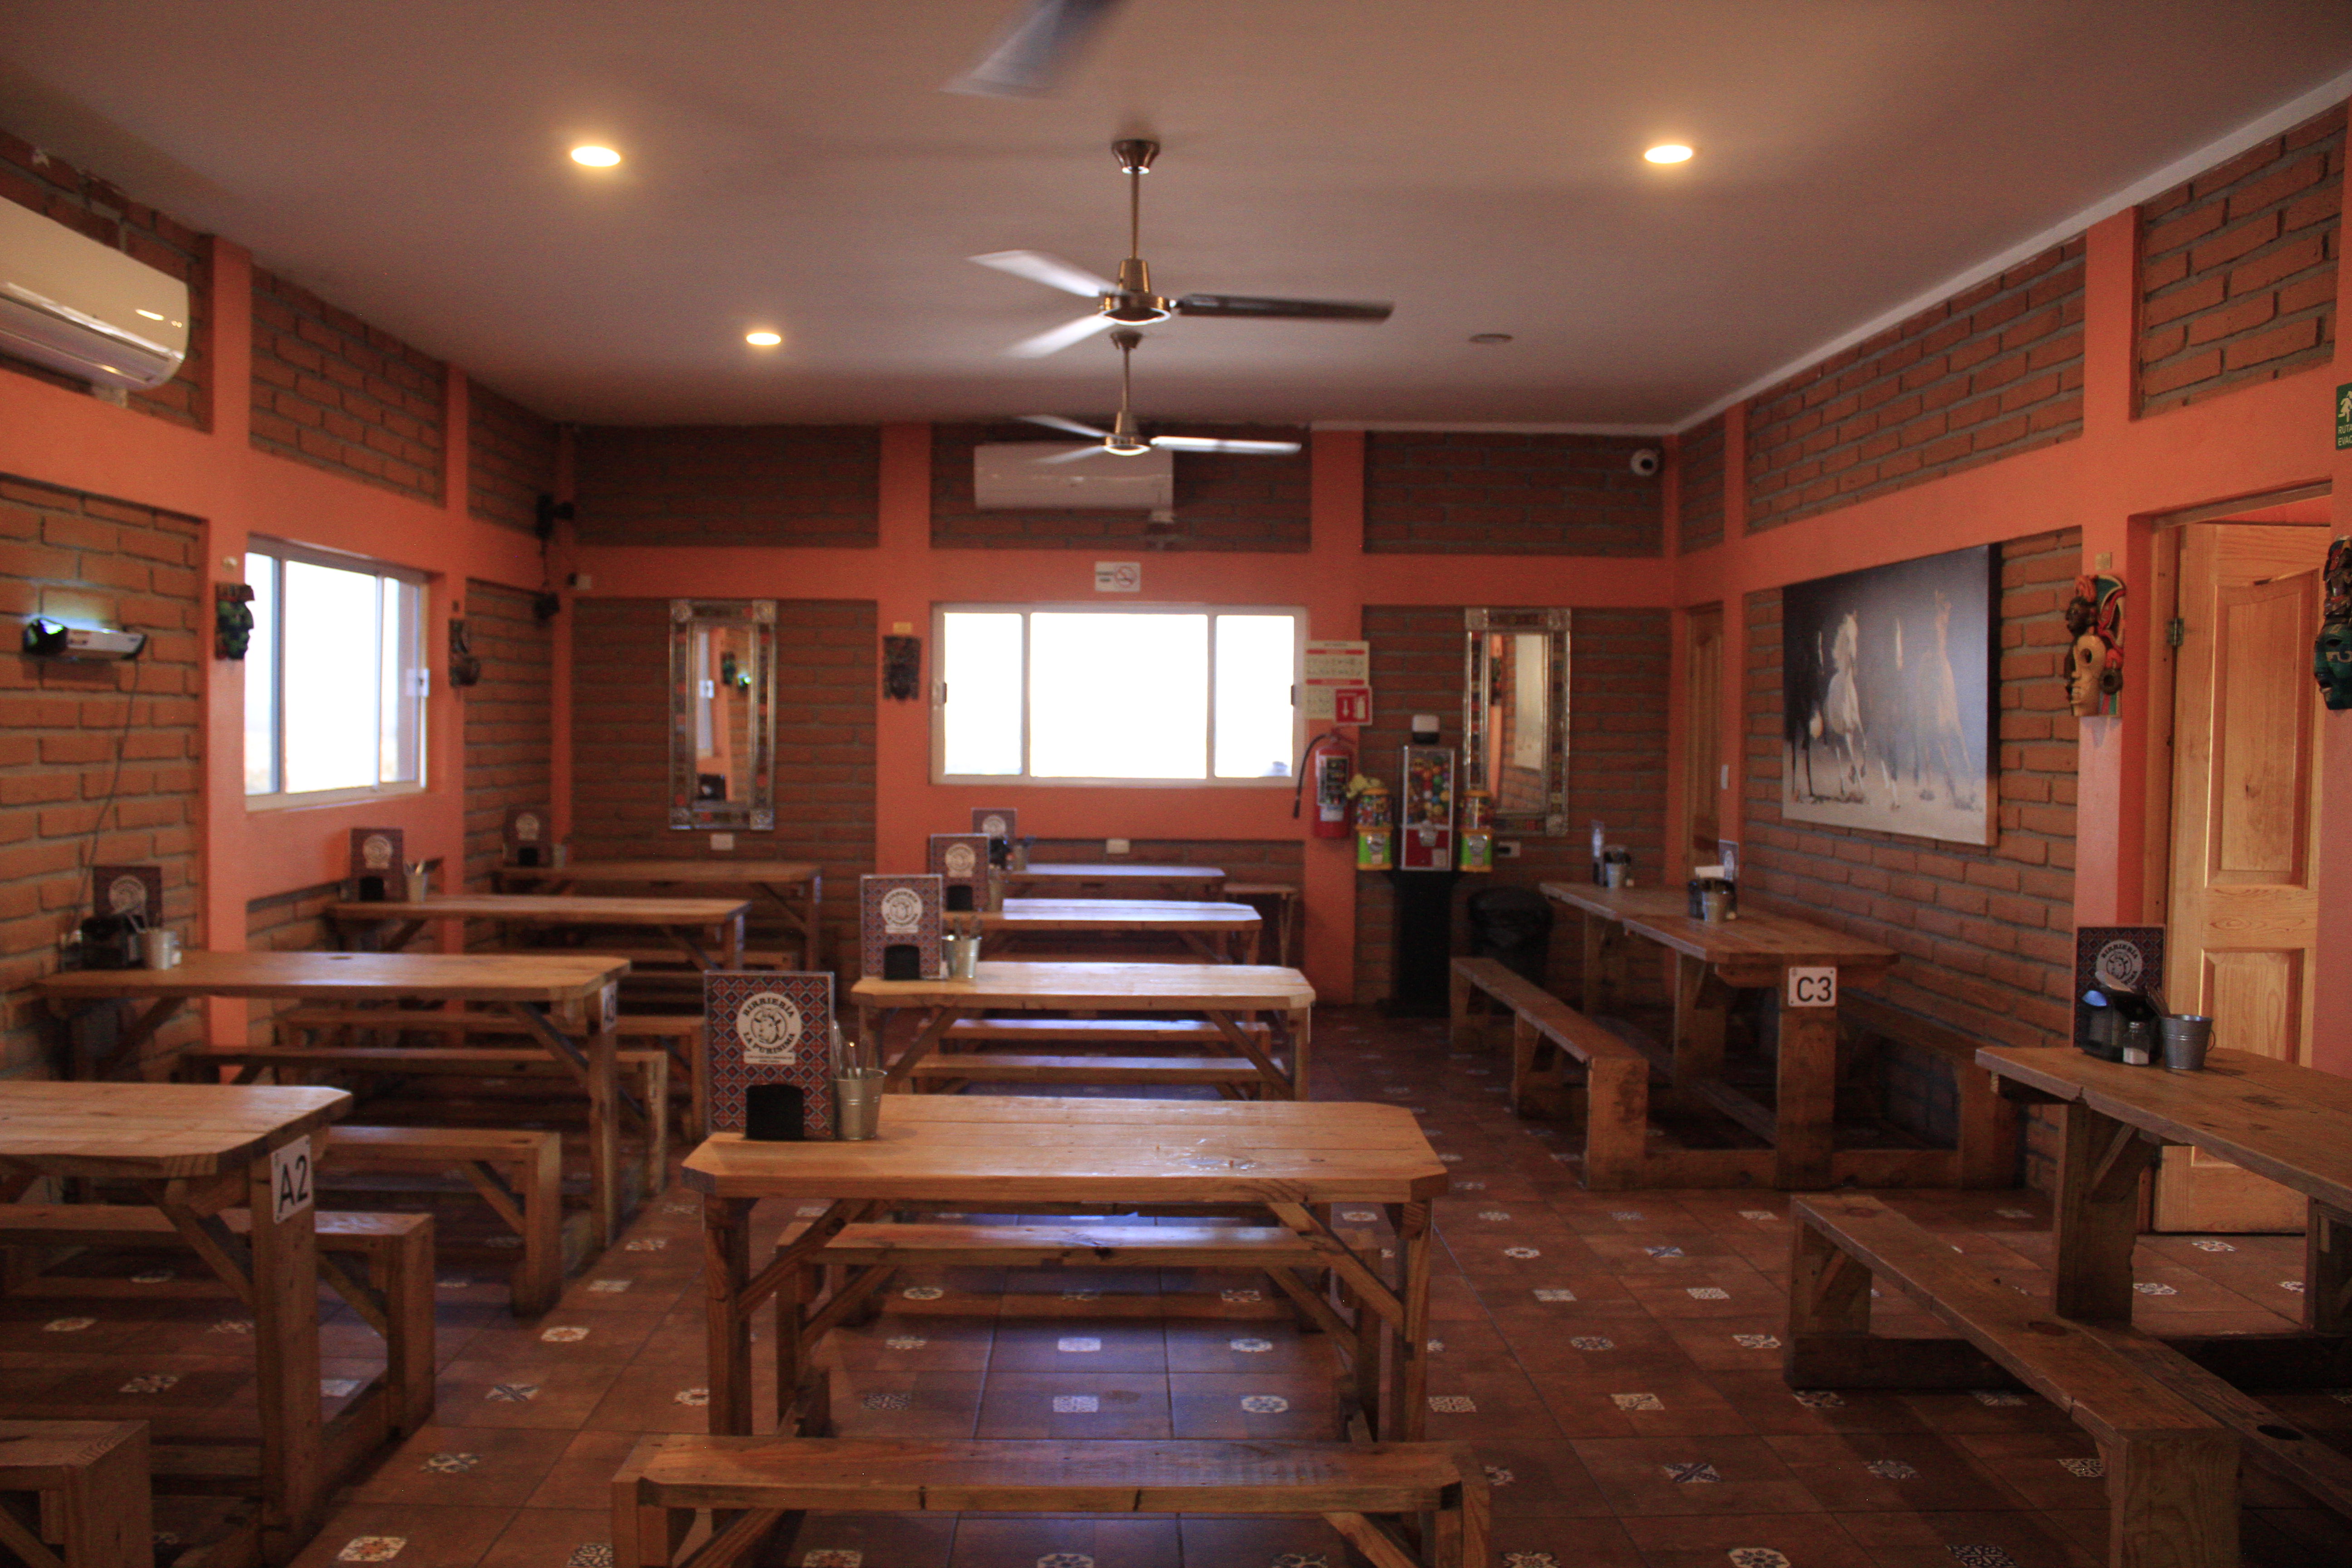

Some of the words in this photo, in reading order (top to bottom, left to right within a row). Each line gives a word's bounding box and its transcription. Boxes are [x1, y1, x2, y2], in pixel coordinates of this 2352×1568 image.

[1797, 976, 1831, 1002] C3
[743, 1032, 752, 1044] LA
[278, 1155, 308, 1213] A2
